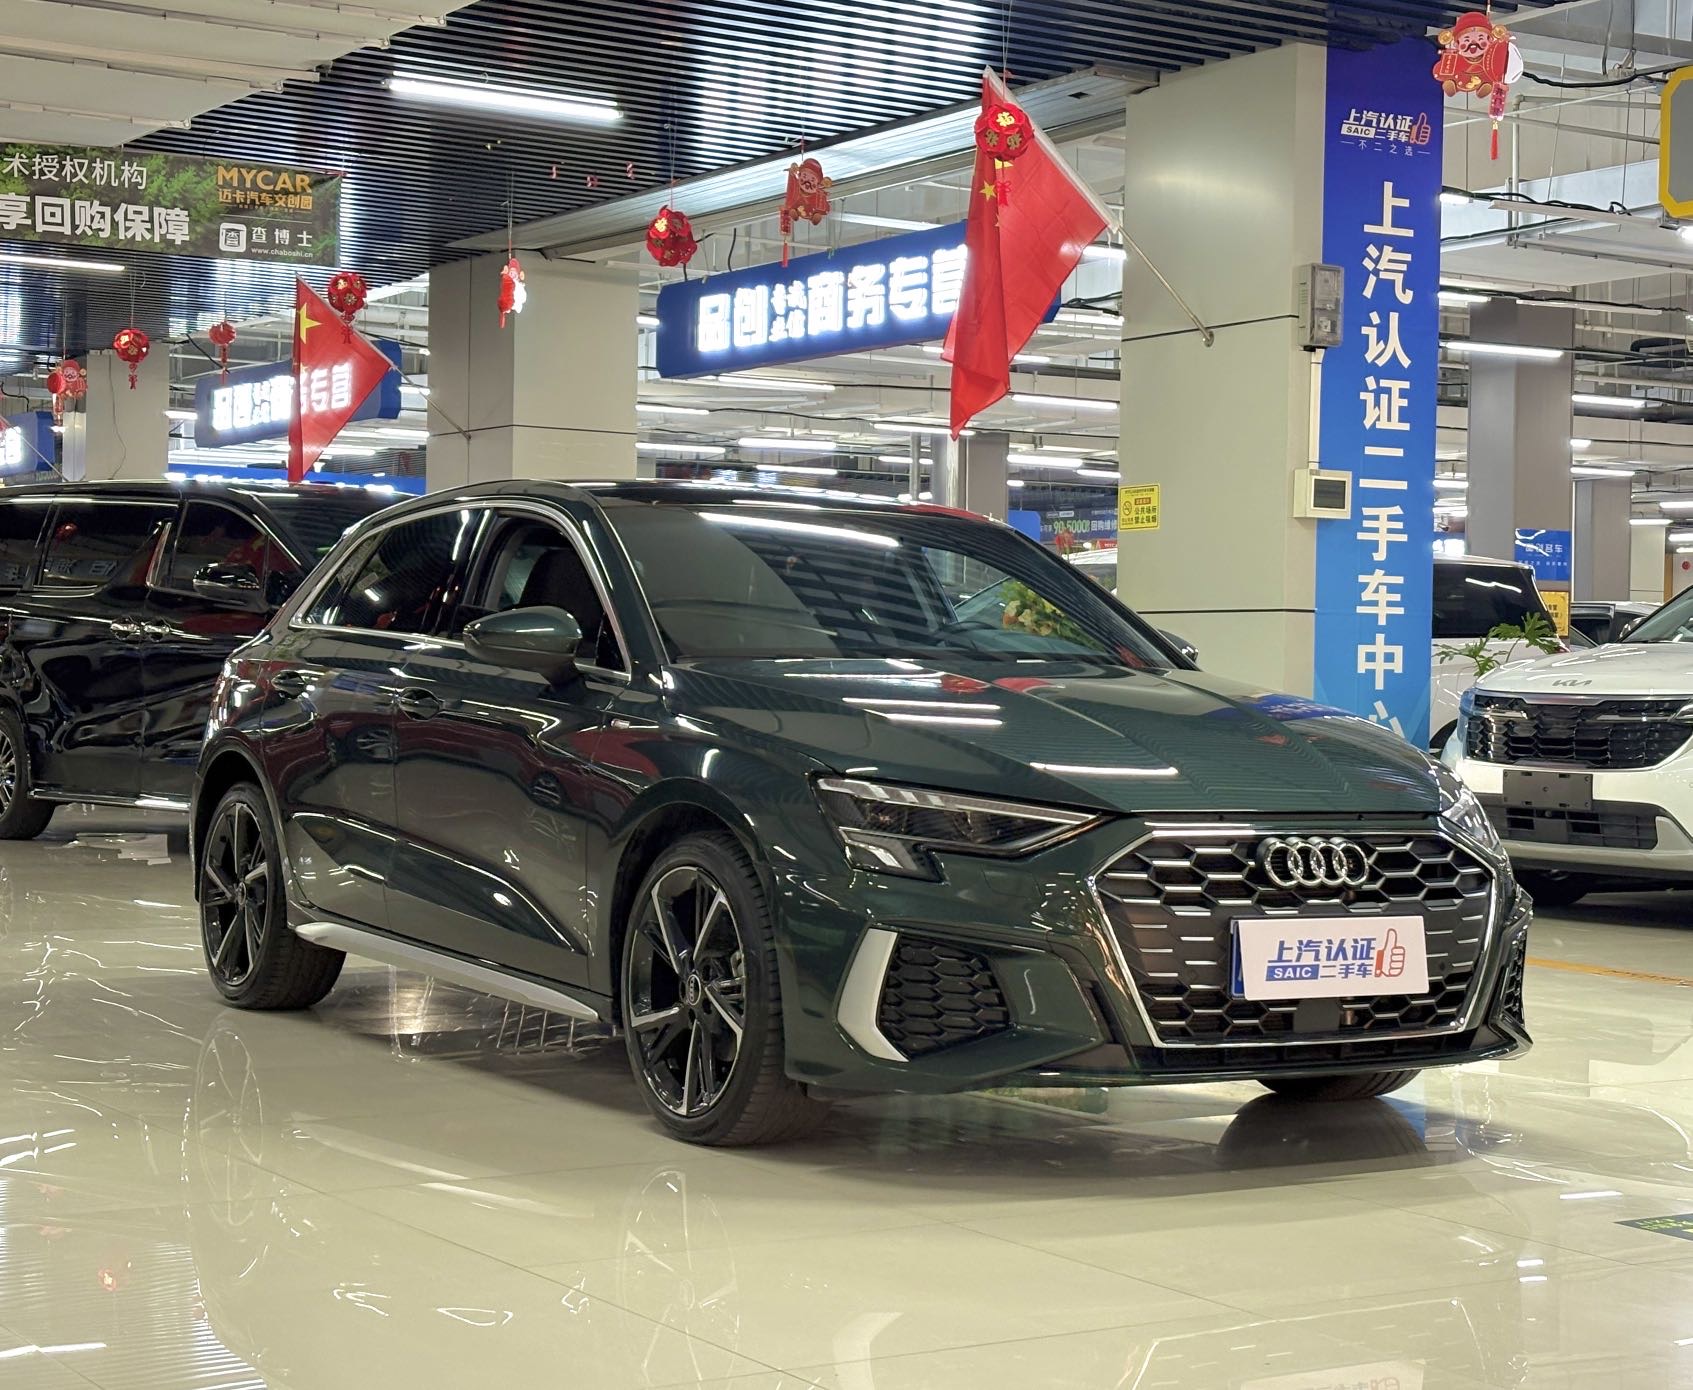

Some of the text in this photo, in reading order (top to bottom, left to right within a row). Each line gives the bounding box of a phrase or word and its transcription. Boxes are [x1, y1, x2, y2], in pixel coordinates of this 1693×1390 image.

[1343, 108, 1414, 131] 上汽认证
[1346, 126, 1371, 136] SAIC
[1375, 129, 1410, 142] 二手车
[1358, 140, 1414, 156] 不二之选
[2, 153, 147, 189] 术授权机构
[217, 165, 312, 193] MYCAR
[0, 192, 190, 245] 享回购保障
[251, 226, 313, 247] 查博士
[251, 247, 313, 258] www.chaboshi.cn
[1267, 937, 1377, 963] 上汽认证
[1273, 966, 1313, 979] SAIC
[1319, 962, 1374, 979] 二手车
